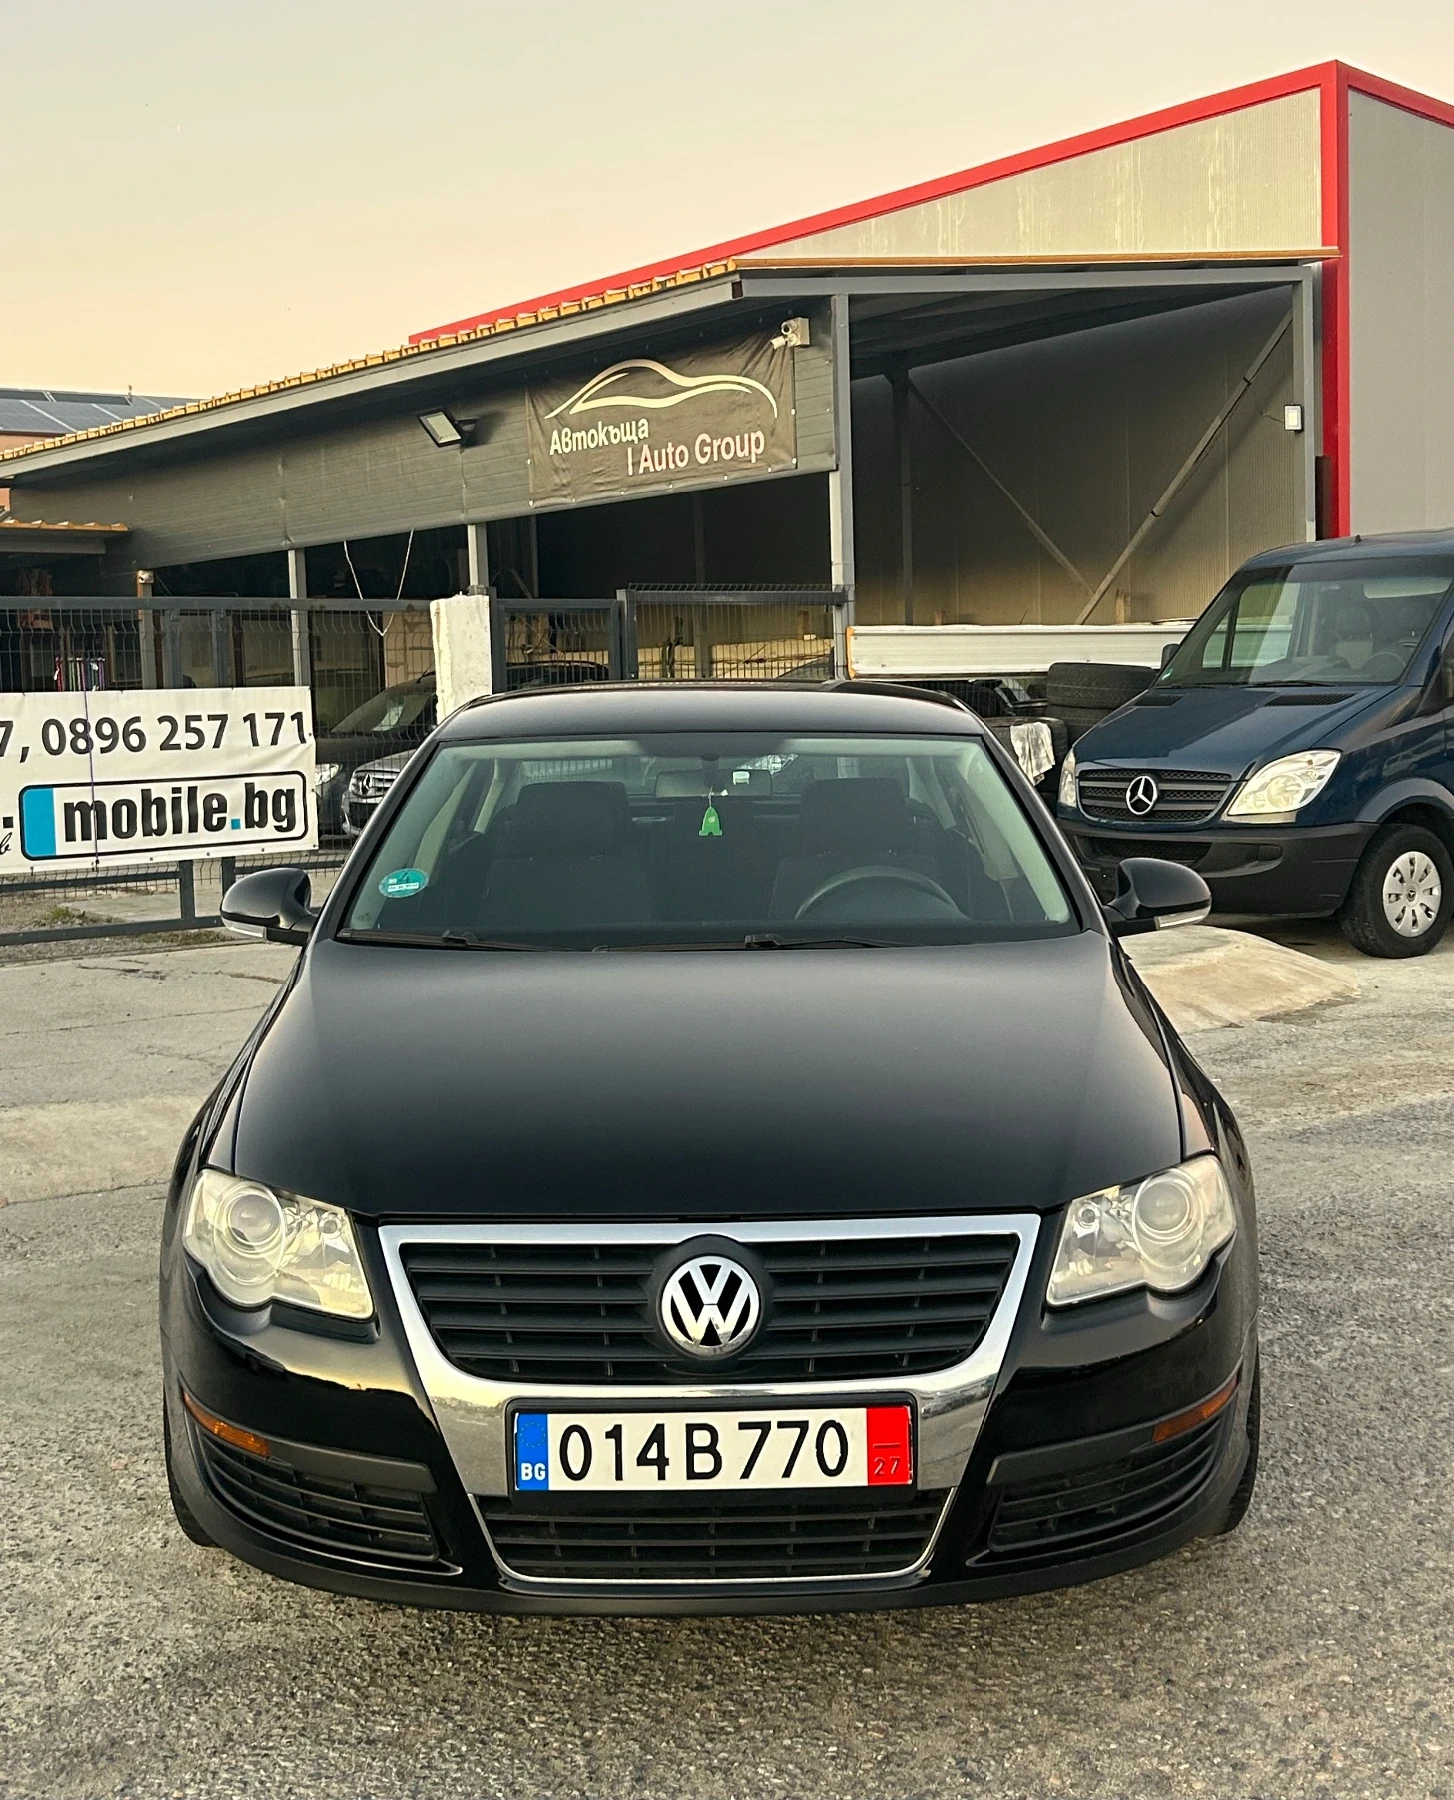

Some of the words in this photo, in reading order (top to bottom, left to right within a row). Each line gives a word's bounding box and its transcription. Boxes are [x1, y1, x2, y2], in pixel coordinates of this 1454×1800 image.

[638, 443, 690, 475] Auto
[694, 430, 766, 464] Group
[41, 716, 148, 756] 0896
[157, 713, 229, 751] 257
[243, 711, 308, 747] 171
[63, 781, 297, 843] mobile.bg
[520, 1462, 547, 1481] BG
